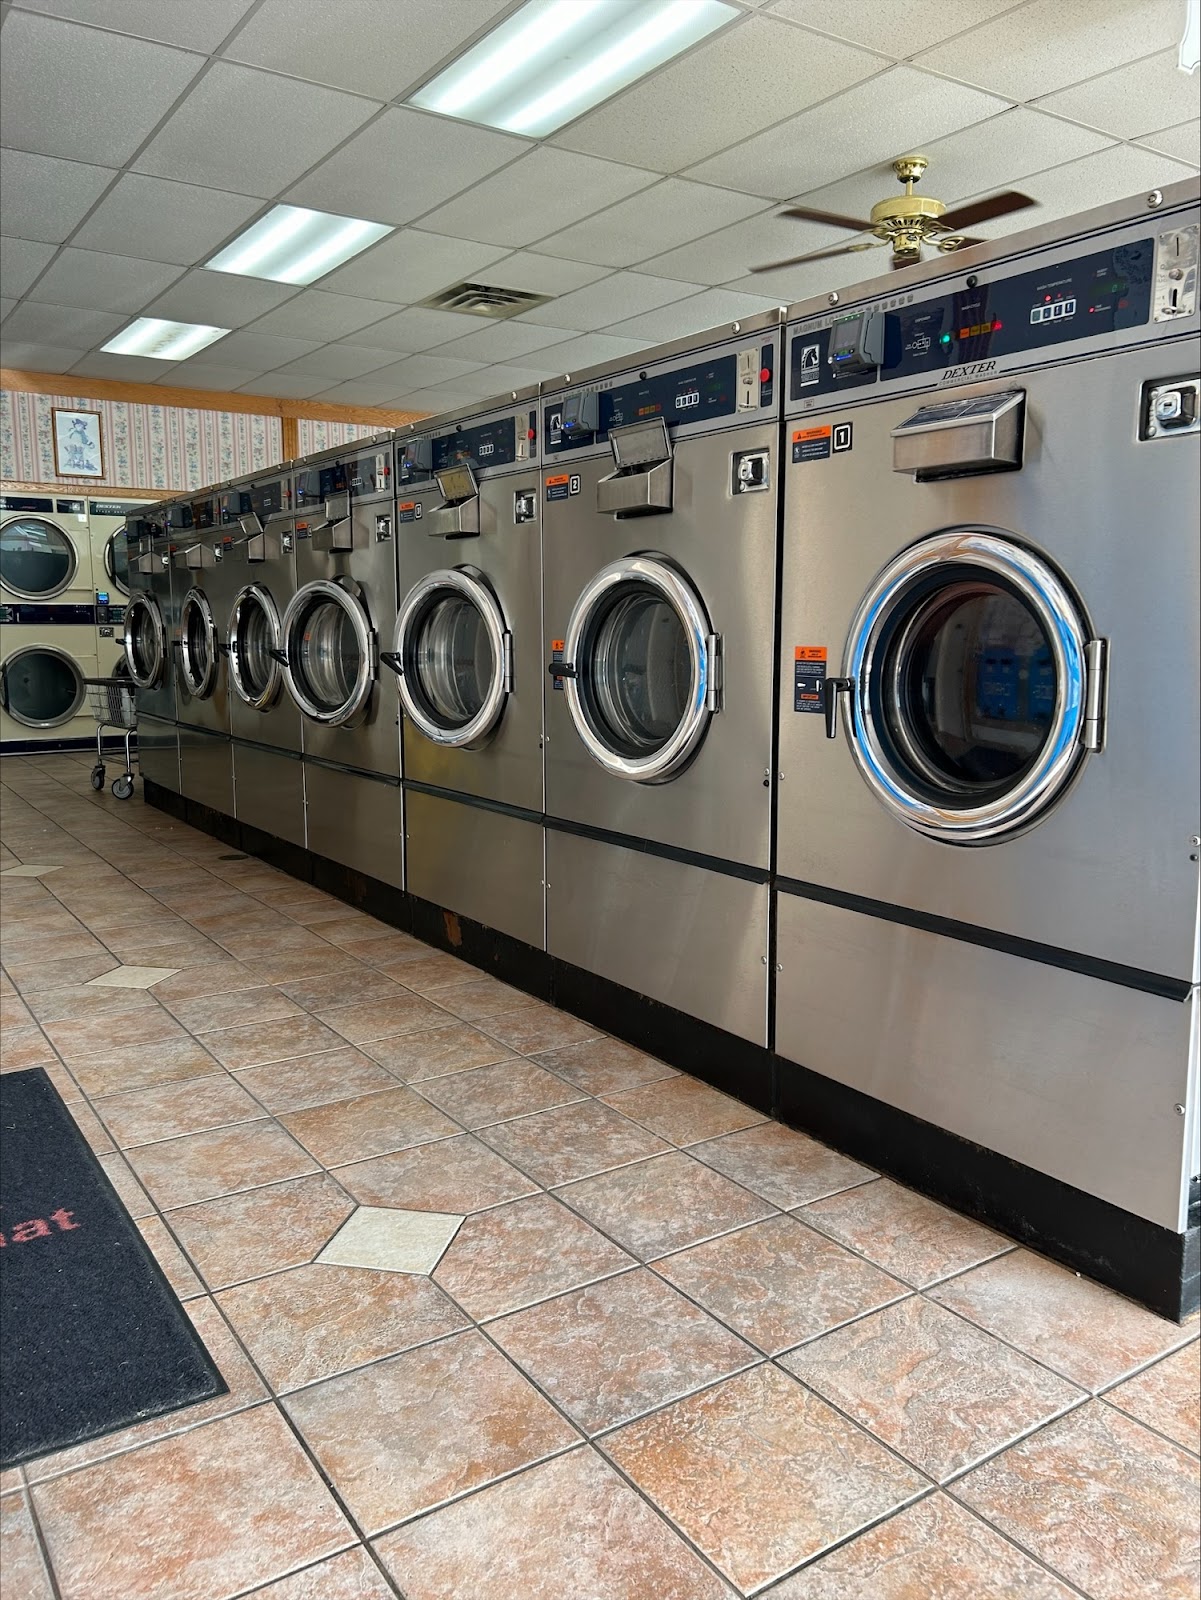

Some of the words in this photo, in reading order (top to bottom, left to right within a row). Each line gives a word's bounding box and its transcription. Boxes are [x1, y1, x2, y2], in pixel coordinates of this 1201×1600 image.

[941, 360, 997, 381] DEXTER
[839, 431, 845, 444] 1
[0, 1207, 81, 1248] at
